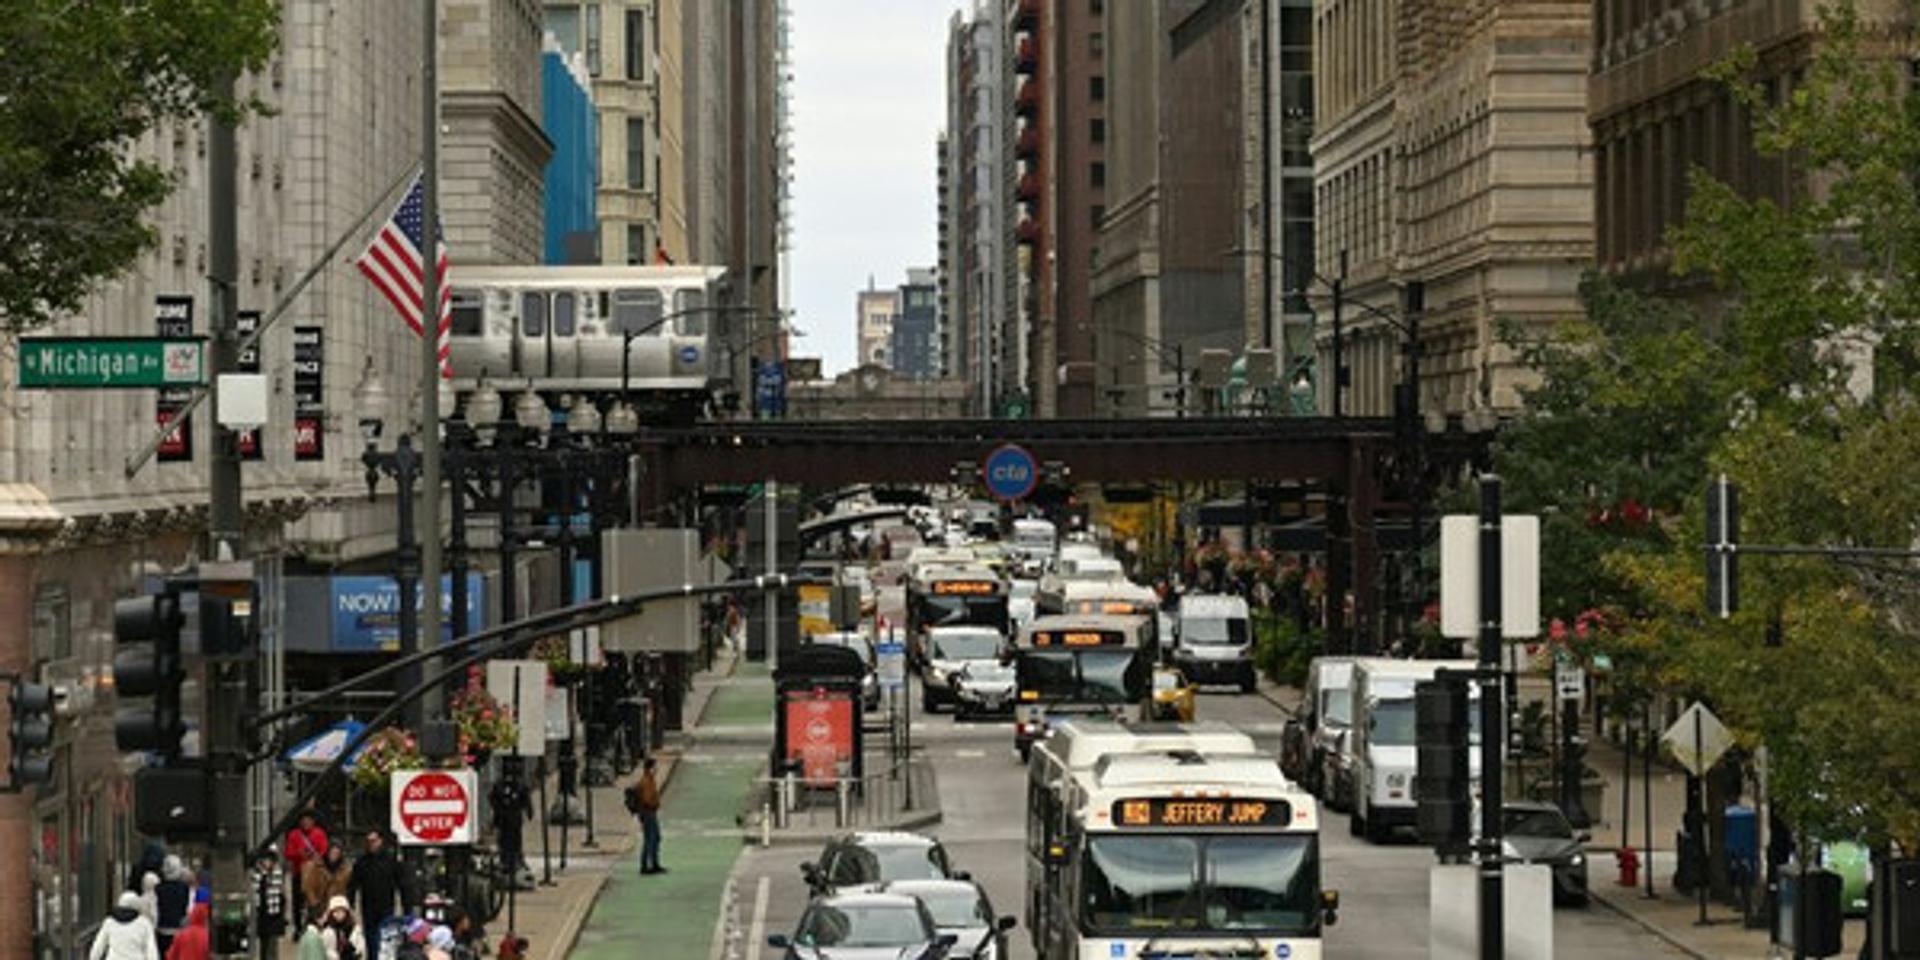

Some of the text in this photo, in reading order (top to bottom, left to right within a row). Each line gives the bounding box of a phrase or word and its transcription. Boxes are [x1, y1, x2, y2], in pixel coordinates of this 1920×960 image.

[40, 349, 138, 382] Michigan
[993, 463, 1029, 482] cta
[339, 594, 392, 612] NOW
[407, 784, 427, 798] DO
[1161, 803, 1224, 824] JEFFERY
[1228, 803, 1266, 824] JUMP
[413, 816, 454, 831] ENTER
